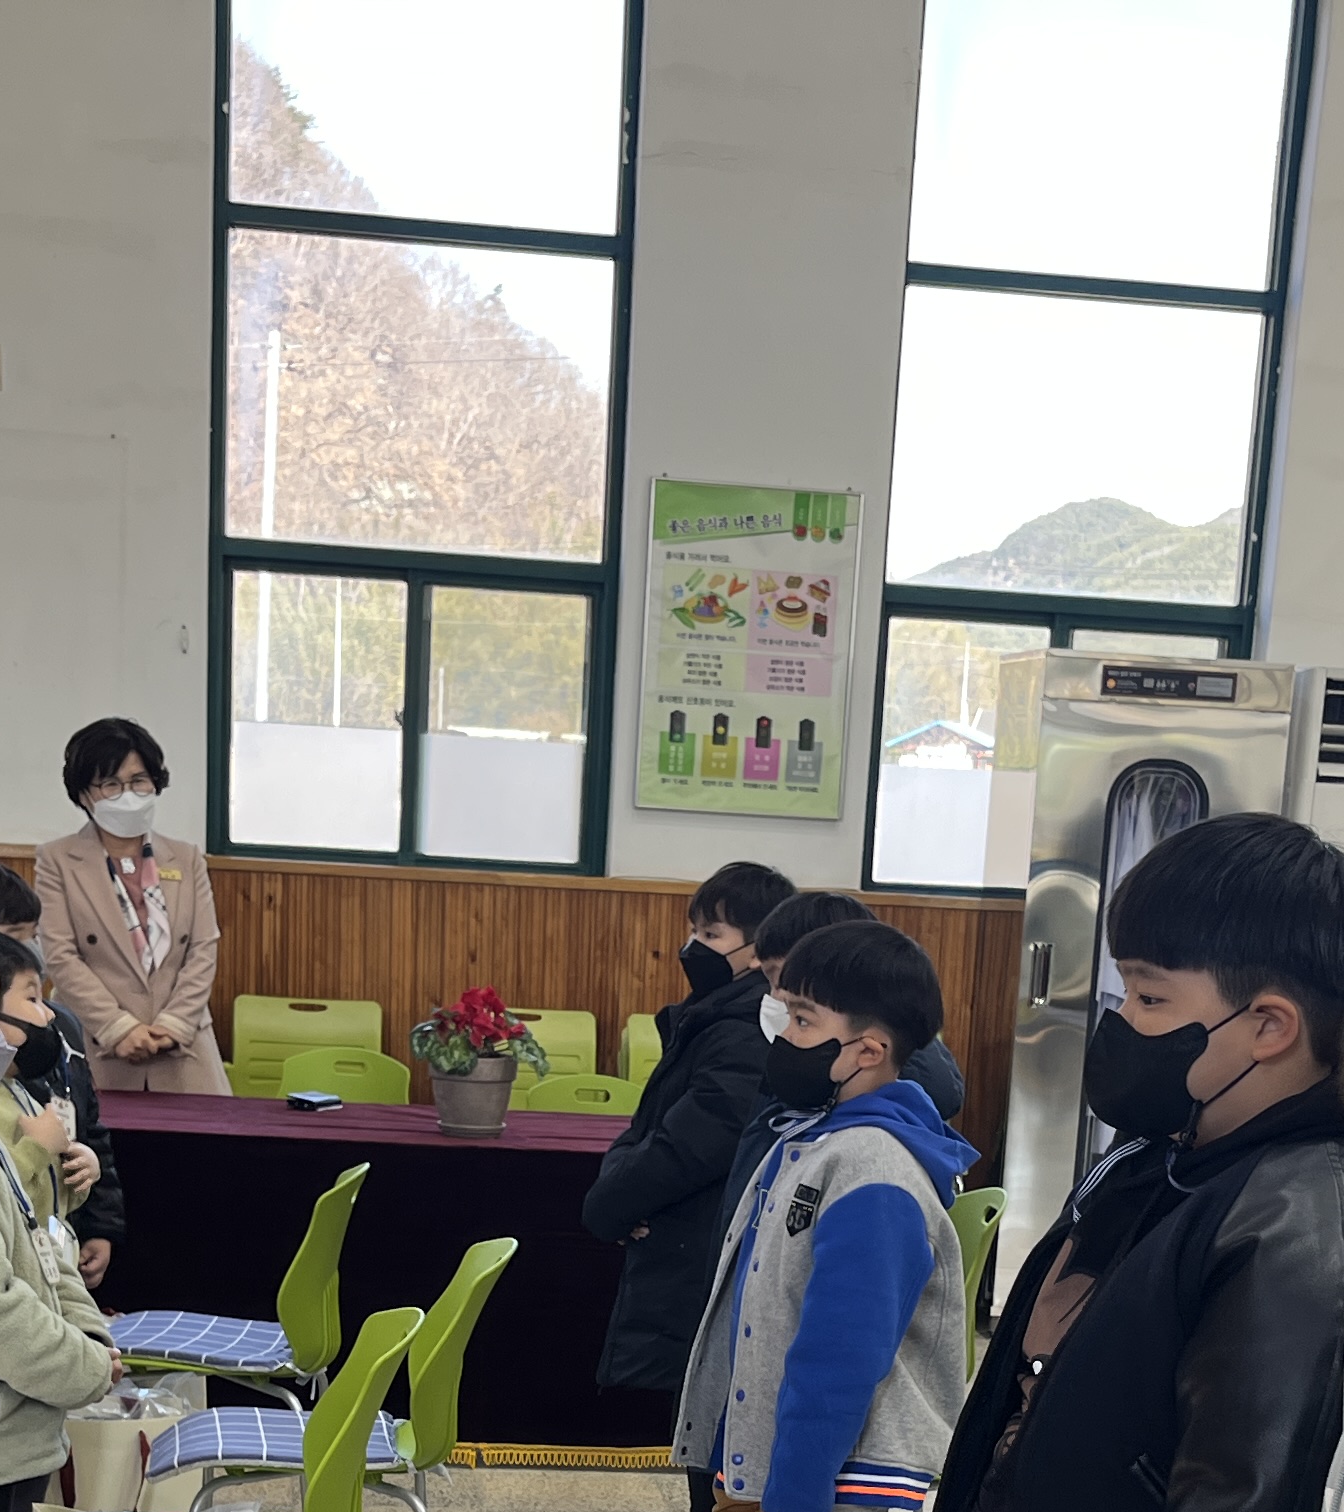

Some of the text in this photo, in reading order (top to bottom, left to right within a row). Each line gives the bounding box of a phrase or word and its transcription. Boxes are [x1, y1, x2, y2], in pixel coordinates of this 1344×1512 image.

[696, 516, 729, 532] 음식과
[733, 515, 755, 530] 나쁜
[761, 512, 783, 529] 음식
